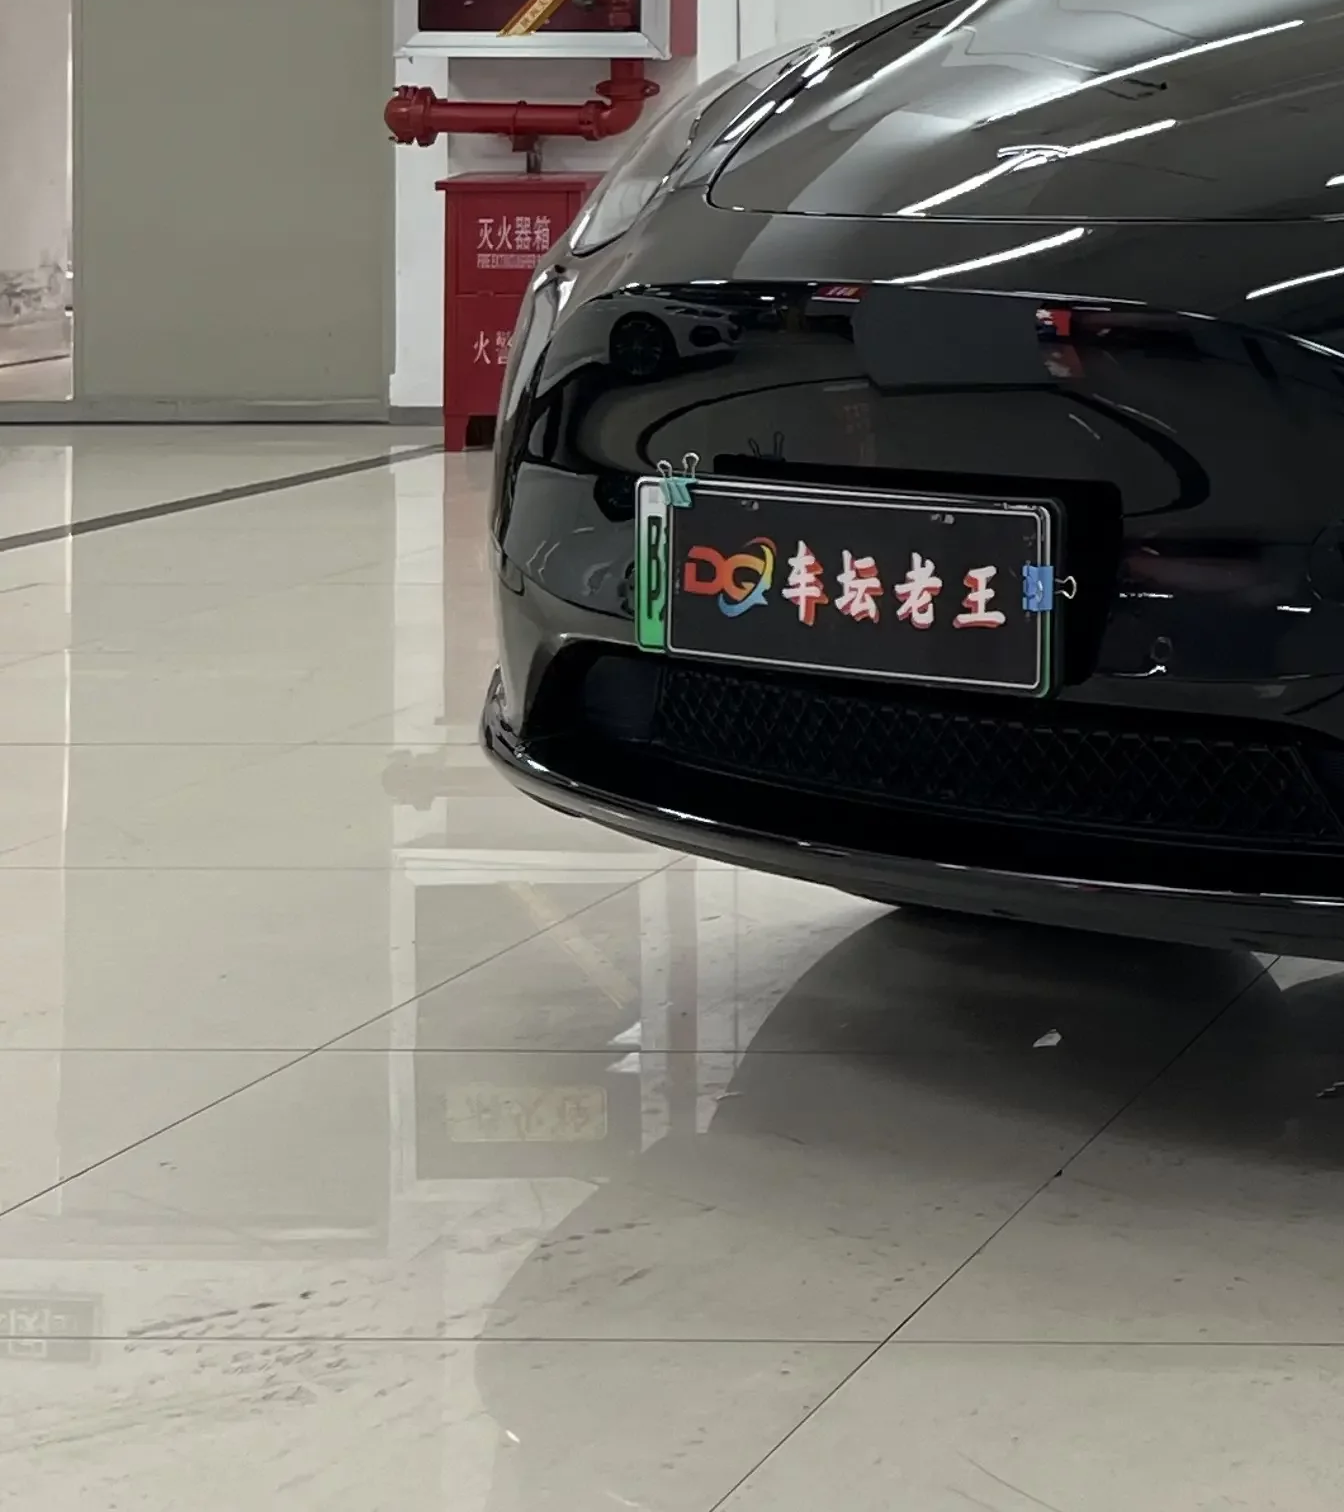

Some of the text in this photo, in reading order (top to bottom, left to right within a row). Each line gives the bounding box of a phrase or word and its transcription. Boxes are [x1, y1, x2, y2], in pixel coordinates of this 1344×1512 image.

[476, 215, 551, 251] 灭火器箱
[781, 539, 1006, 629] 车坛老王
